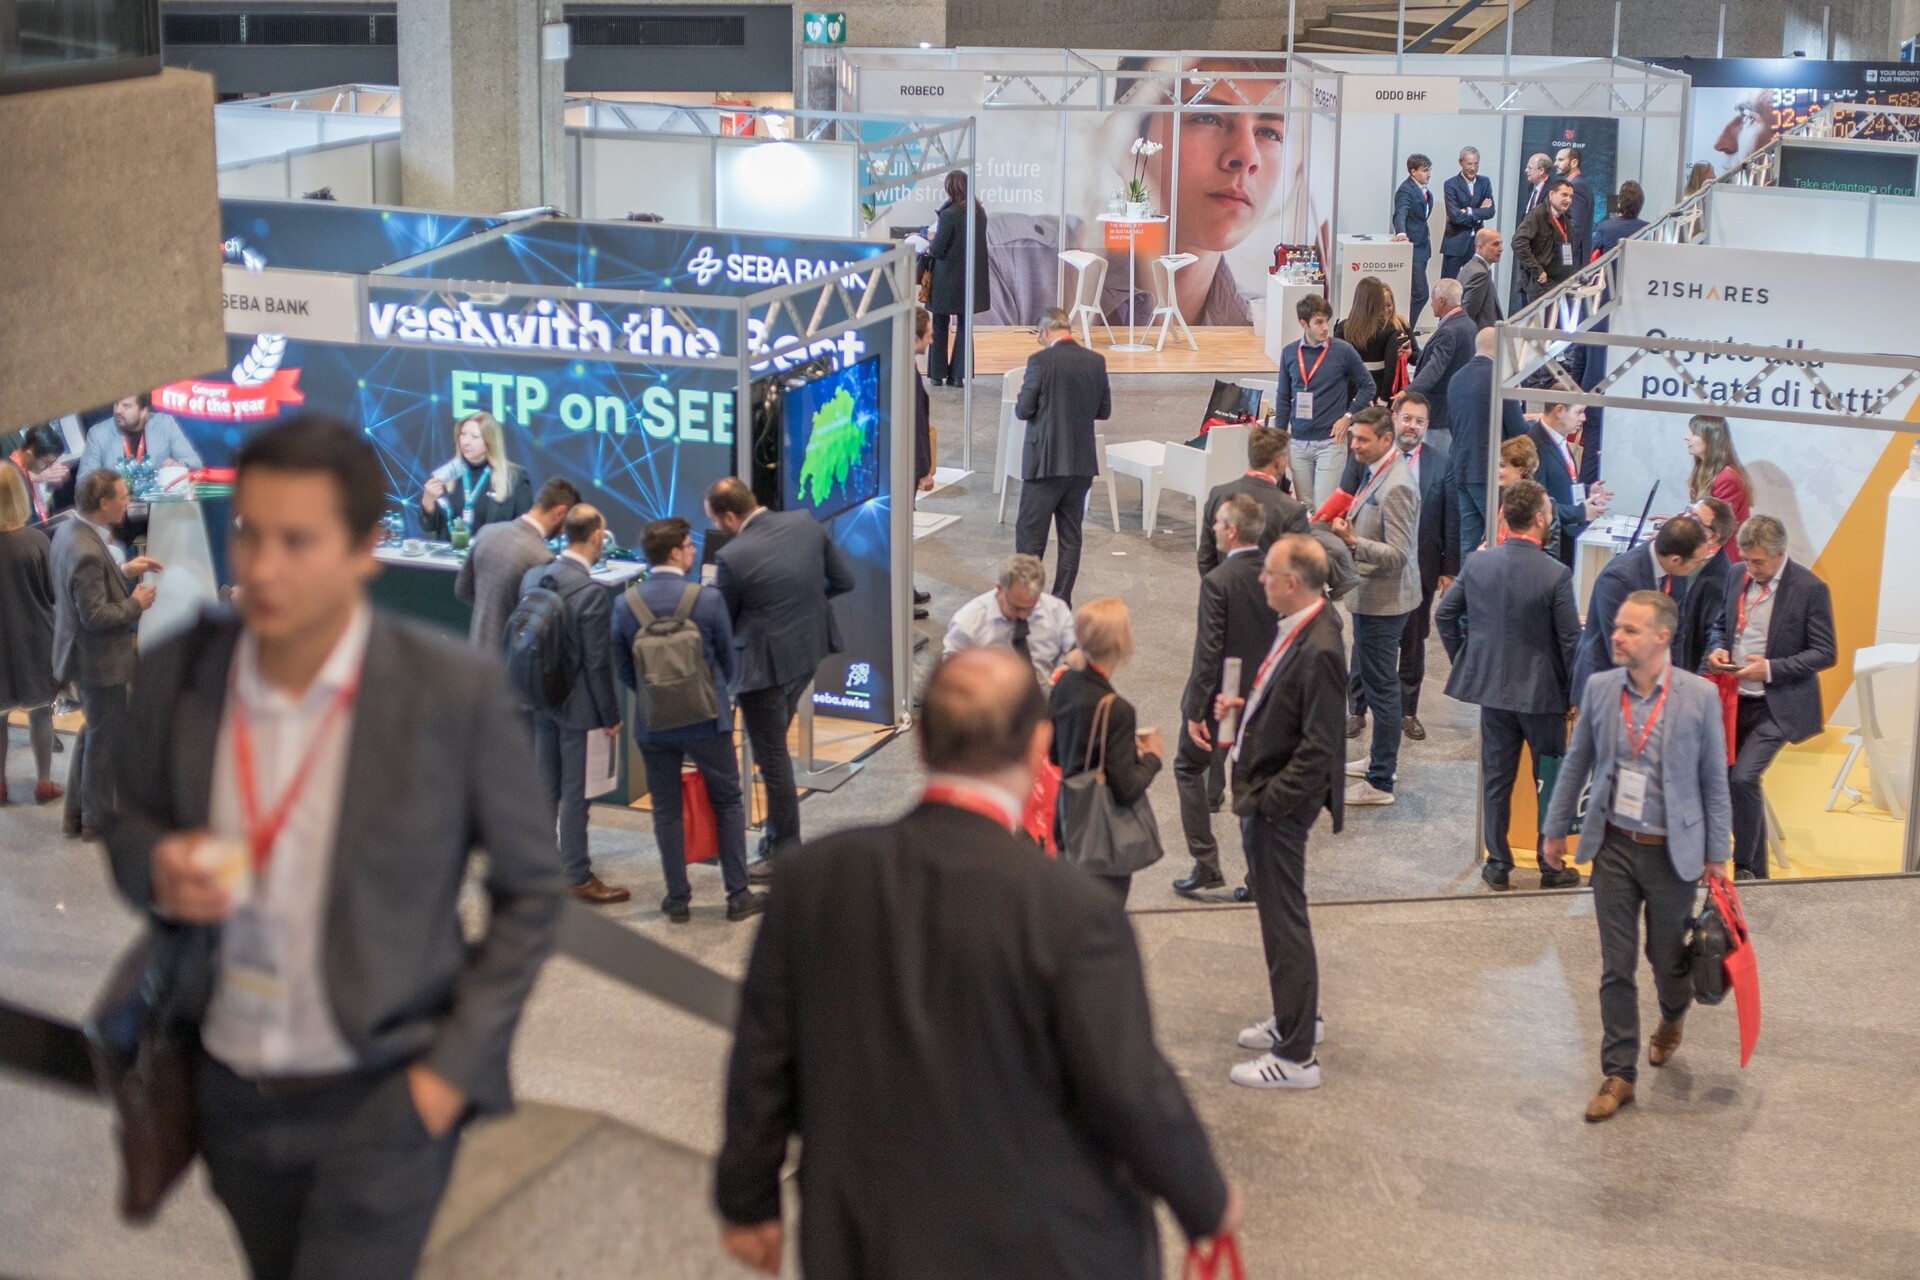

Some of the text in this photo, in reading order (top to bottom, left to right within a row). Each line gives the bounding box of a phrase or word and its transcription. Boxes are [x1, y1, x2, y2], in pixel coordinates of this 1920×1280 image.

[900, 85, 945, 96] ROBECO
[1375, 90, 1427, 101] ODDO BHF
[987, 158, 1041, 178] future
[875, 184, 911, 202] with
[980, 187, 1043, 204] returns
[1794, 178, 1912, 196] Take advantage of our
[726, 254, 793, 284] SEBA
[1647, 279, 1770, 304] 21SHARES
[222, 293, 310, 316] SEBA BANK
[489, 299, 612, 352] with
[623, 307, 721, 359] the
[191, 384, 228, 398] Category
[1641, 373, 1883, 416] portata di tutti
[161, 389, 267, 418] ETP of the year
[451, 369, 549, 426] ETP
[559, 391, 628, 435] on
[813, 692, 870, 709] seba.swiss
